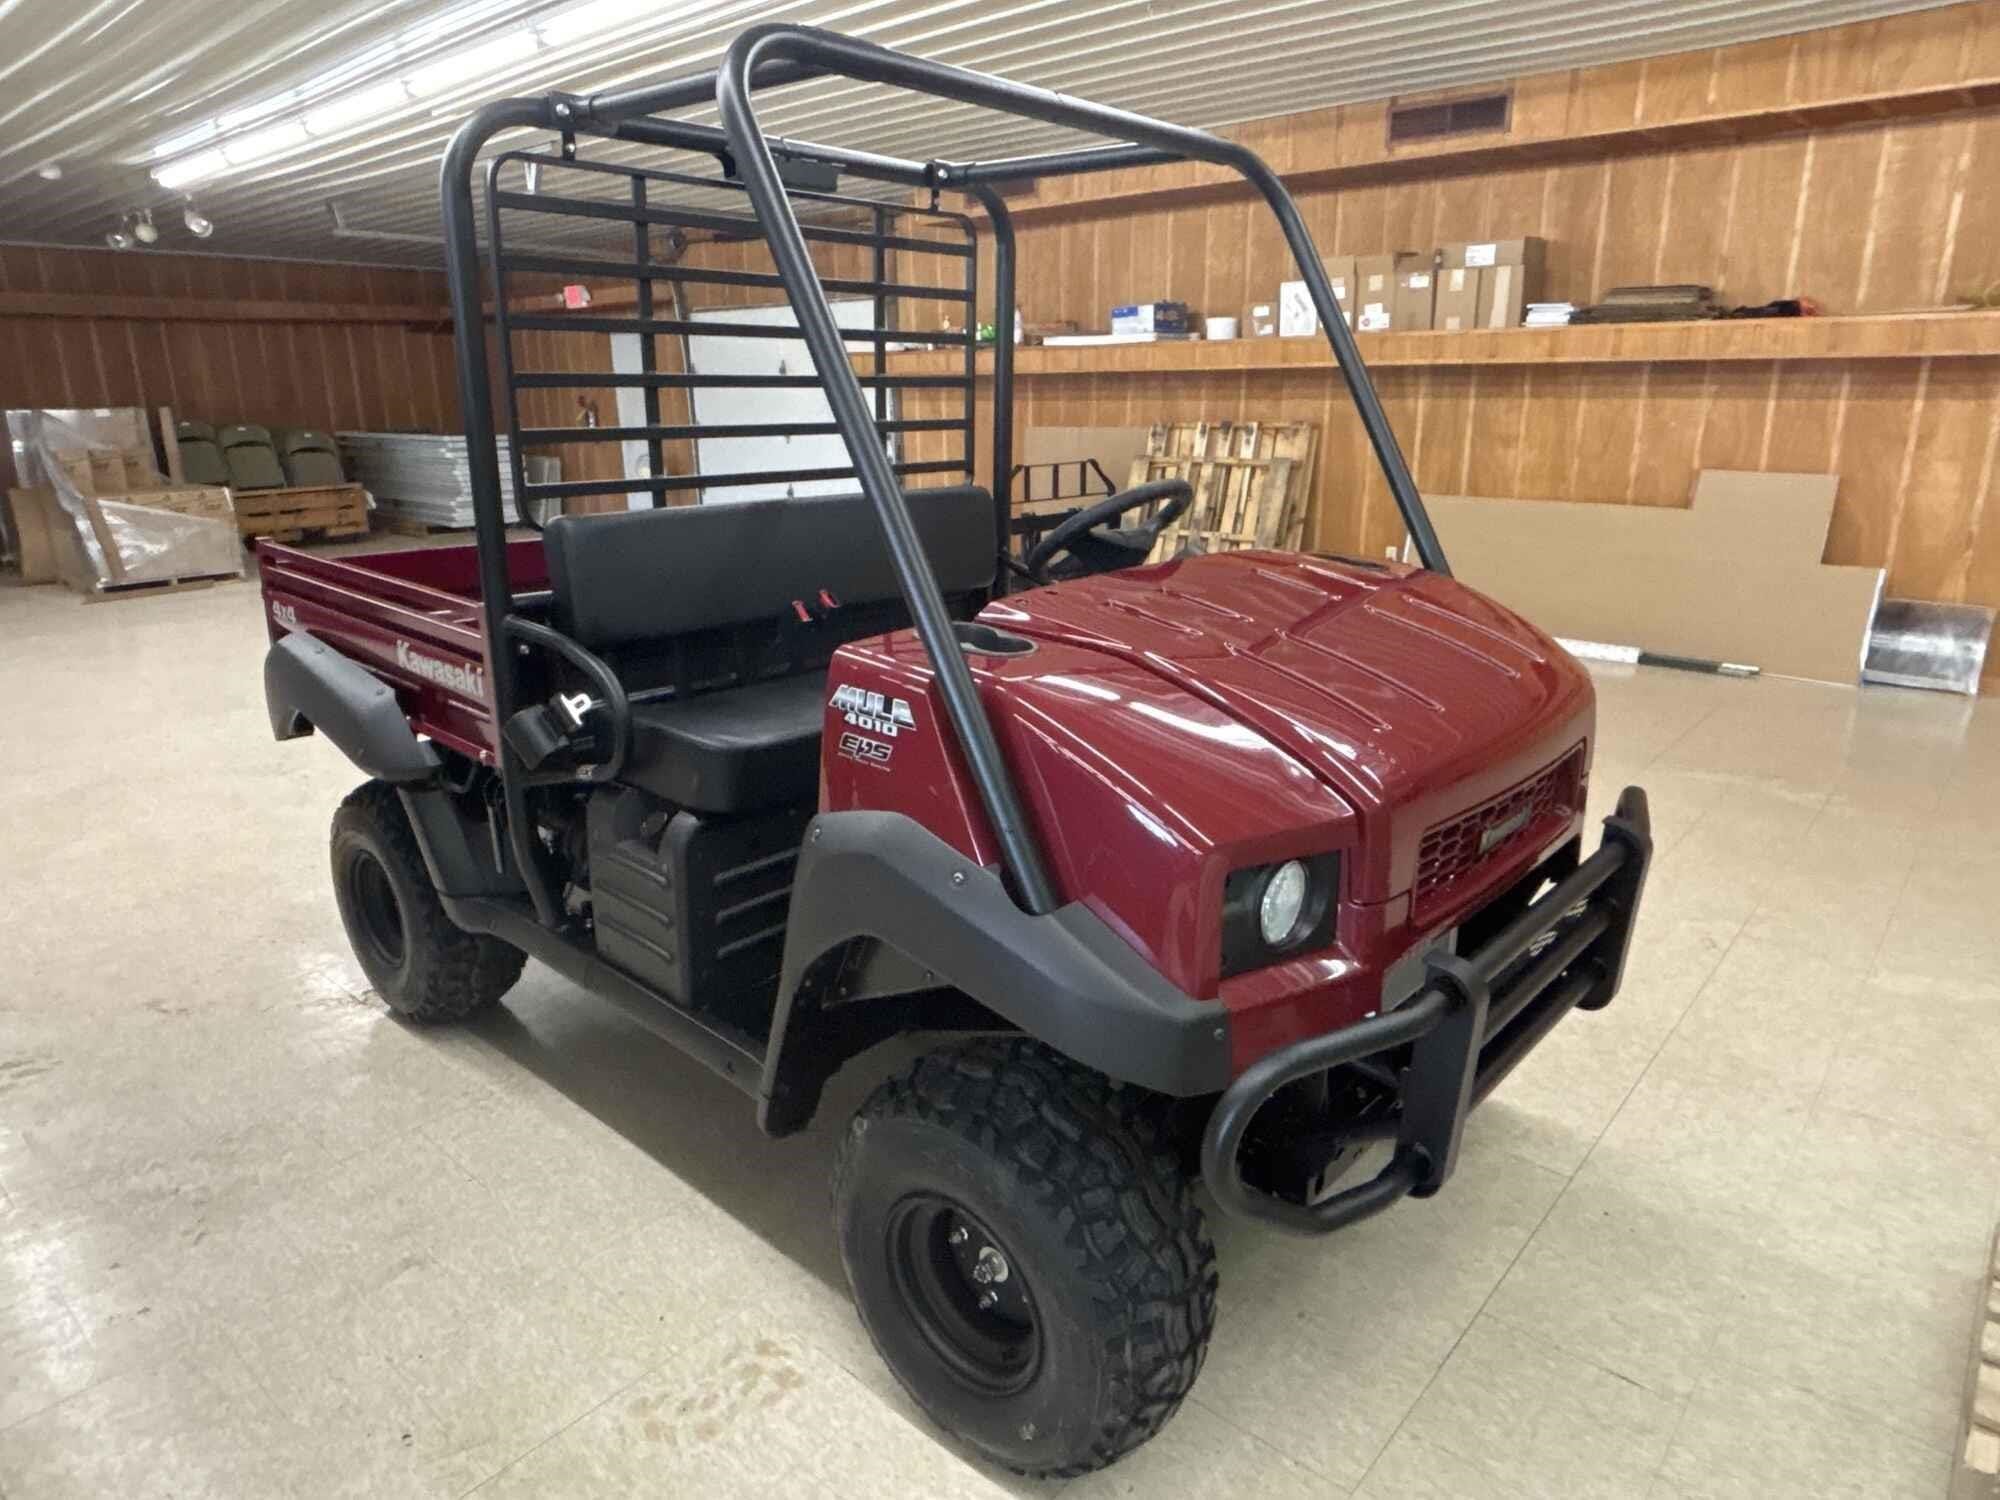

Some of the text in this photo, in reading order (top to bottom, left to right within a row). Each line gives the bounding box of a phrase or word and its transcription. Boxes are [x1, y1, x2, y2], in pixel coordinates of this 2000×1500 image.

[396, 639, 483, 697] Kawasaki
[844, 711, 898, 737] 4010
[839, 731, 893, 762] EPS
